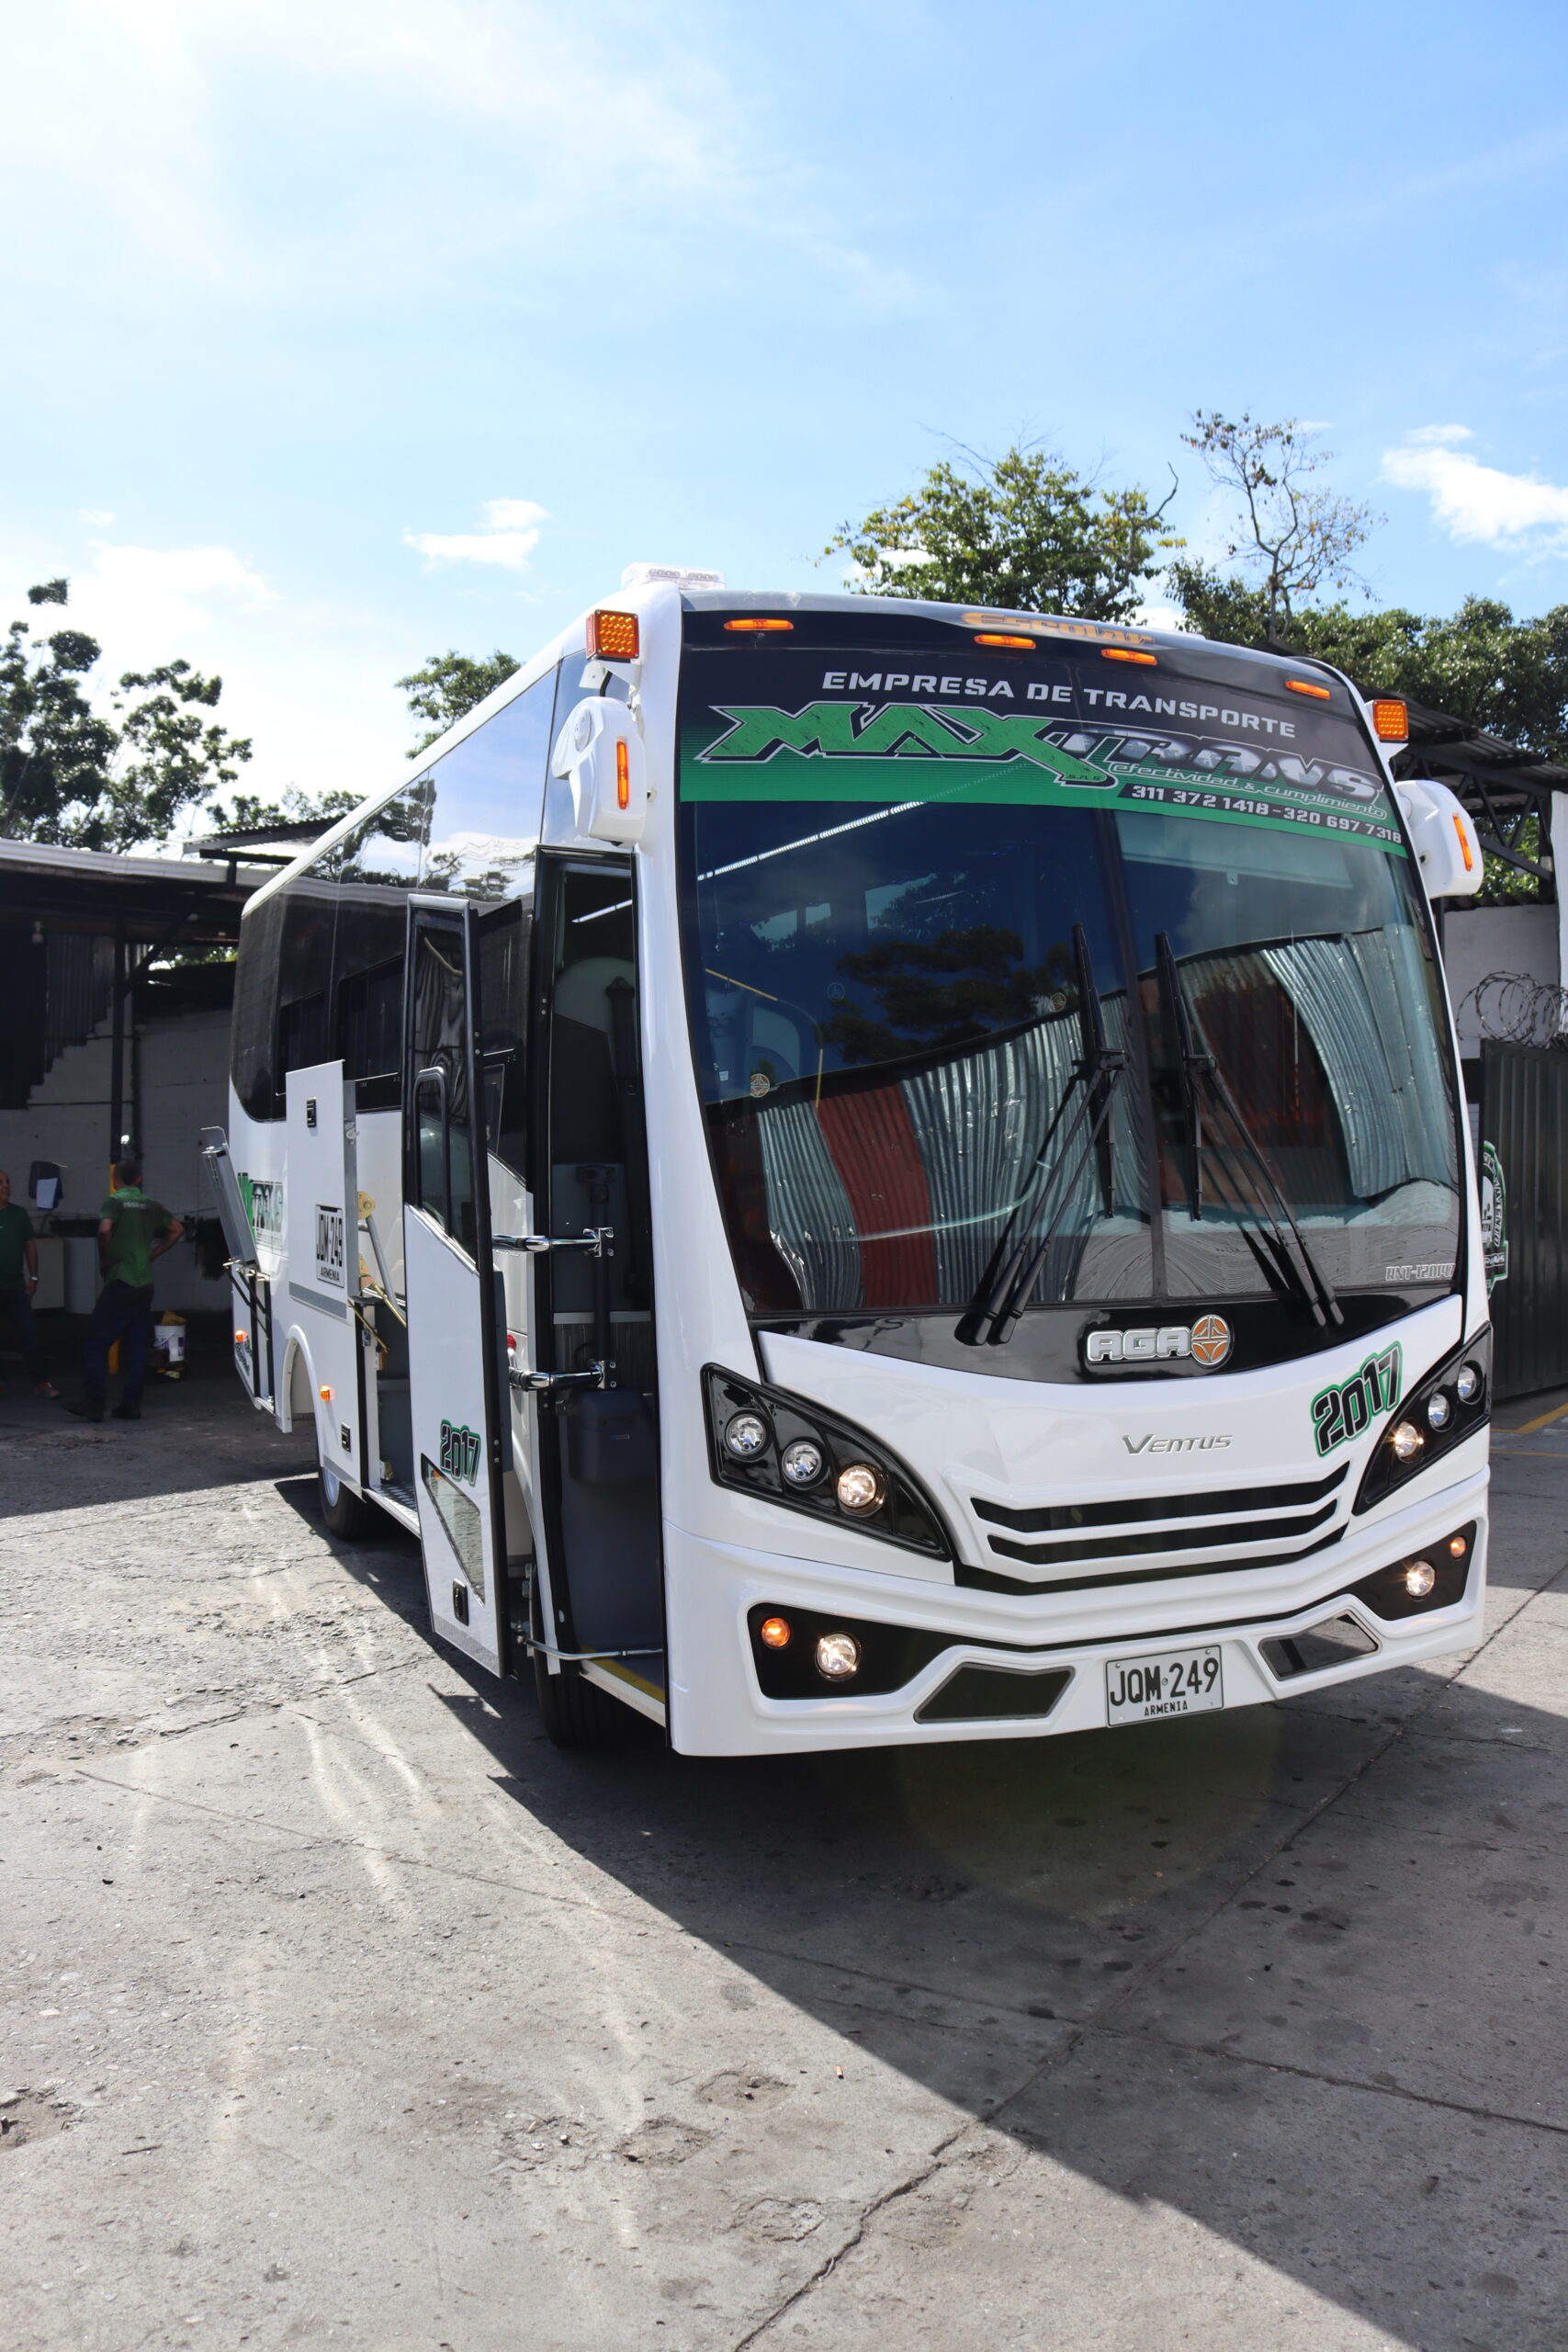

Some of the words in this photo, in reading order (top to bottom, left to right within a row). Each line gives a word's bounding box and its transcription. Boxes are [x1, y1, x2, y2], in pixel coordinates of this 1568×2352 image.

[961, 612, 1156, 645] Escolar
[822, 672, 1014, 698] EMPRESA
[1026, 683, 1073, 703] DE
[1083, 688, 1295, 739] TRANSPORTE
[694, 701, 1118, 788] MAX
[1131, 785, 1165, 801] 311
[1172, 789, 1216, 808] 372
[1326, 815, 1360, 832] 697
[1365, 823, 1402, 844] 7318
[1263, 786, 1386, 819] cumplimiento
[1088, 1327, 1192, 1362] AGA
[1311, 1340, 1403, 1457] 2017
[440, 1419, 480, 1487] 2017
[1145, 1700, 1189, 1716] ARMENIA
